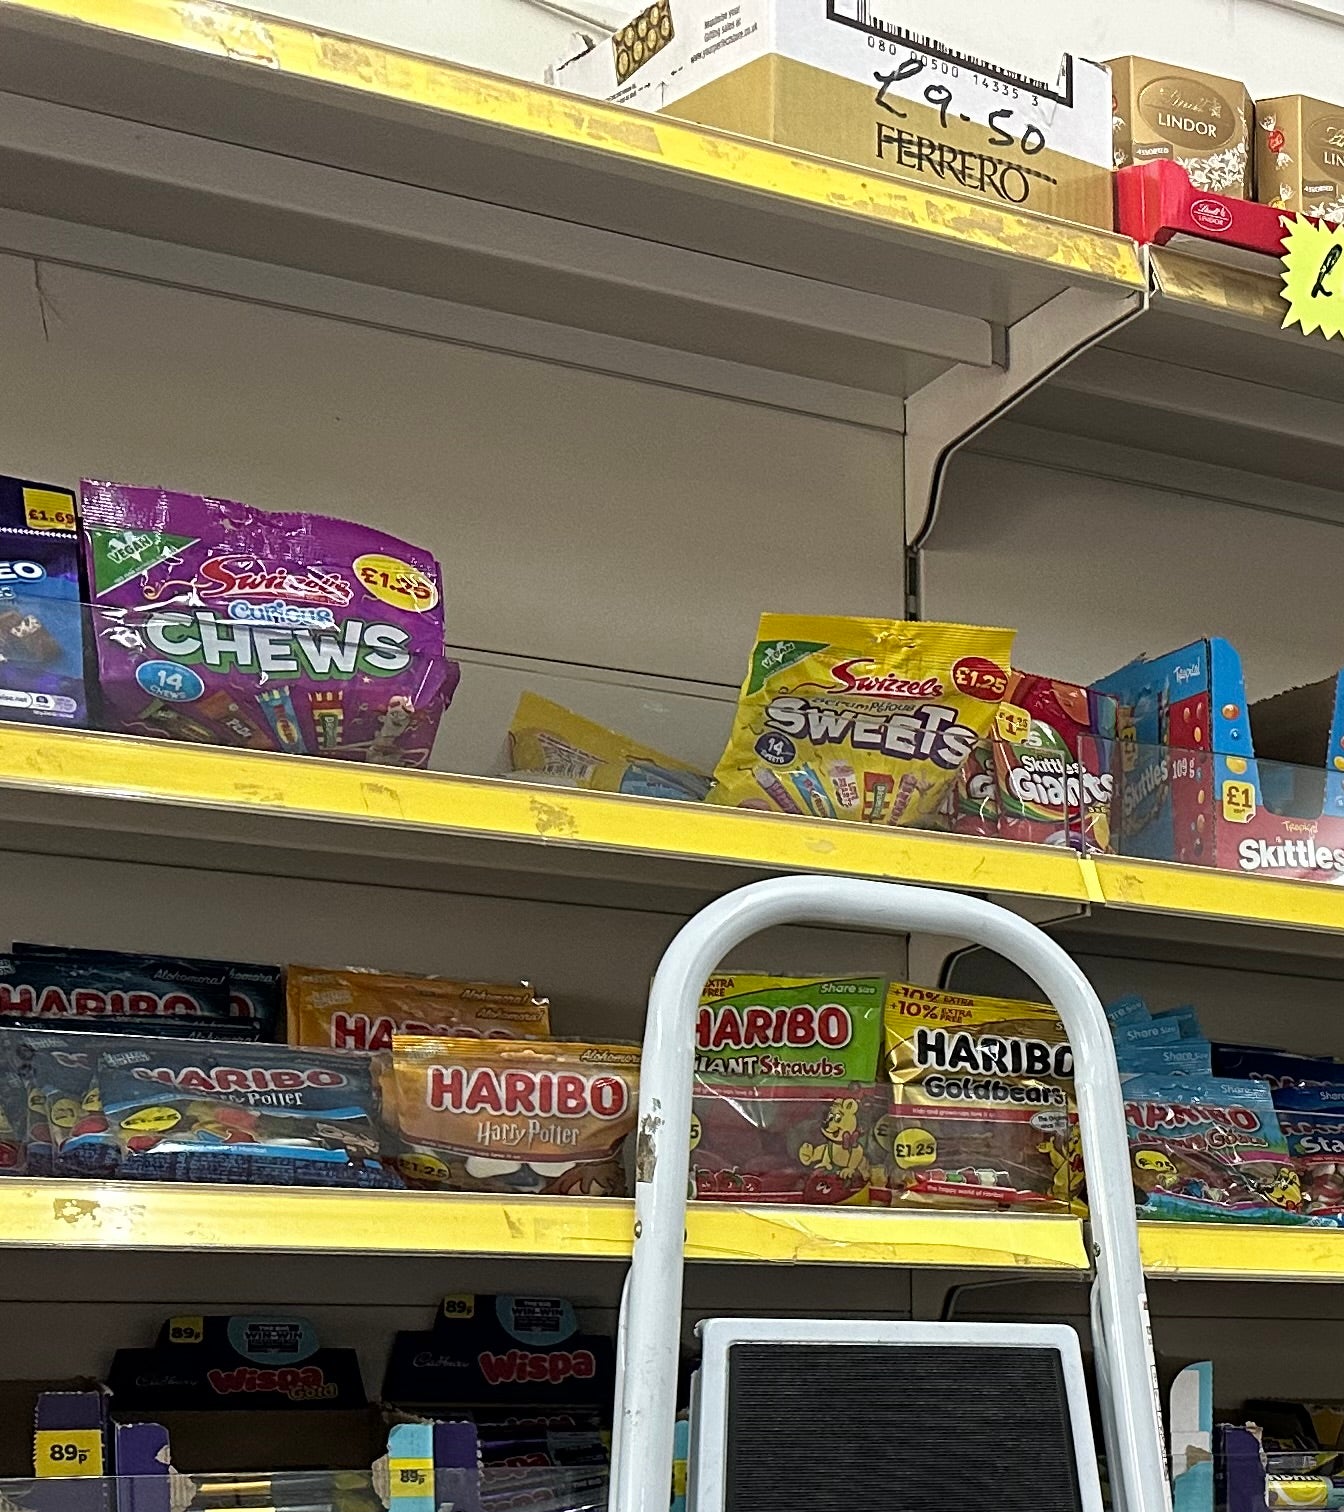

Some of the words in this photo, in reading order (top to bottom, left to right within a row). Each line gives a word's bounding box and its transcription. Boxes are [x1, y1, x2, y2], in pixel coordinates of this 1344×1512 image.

[867, 35, 897, 56] 080
[973, 74, 1019, 100] 14335
[1031, 95, 1039, 107] 3
[1158, 112, 1217, 138] LINDOR
[876, 122, 1030, 203] FERRERO
[1135, 146, 1171, 157] ASSORTED
[1304, 184, 1335, 194] ASSORTED
[1198, 214, 1226, 227] LINDOR
[29, 509, 75, 524] £1.69
[108, 535, 152, 563] VEGAN
[360, 566, 435, 600] £1.25
[145, 610, 411, 676] CHEWS
[761, 642, 796, 669] VEGAN
[158, 668, 183, 692] 14
[827, 658, 945, 699] Swizzels
[955, 666, 1007, 694] £1.25
[765, 696, 979, 769] SWEETS
[999, 711, 1029, 736] £1.25
[768, 737, 784, 754] 14
[1021, 754, 1086, 775] Skittles
[1012, 767, 1114, 806] Giants
[1227, 785, 1252, 808] £1
[820, 982, 857, 994] Share
[890, 1001, 938, 1020] +10%
[940, 1007, 973, 1019] EXTRA
[1127, 1026, 1159, 1041] Share
[915, 1029, 1074, 1078] HARIBO
[759, 1055, 845, 1077] Strawbs
[131, 1066, 348, 1093] HARIBO
[924, 1076, 1067, 1106] Goldbears
[428, 1066, 628, 1120] HARIBO
[476, 1119, 528, 1146] Harry
[528, 1123, 580, 1148] Potter
[896, 1142, 936, 1158] £1.25
[400, 1157, 449, 1179] £1.25
[446, 1300, 471, 1316] 89p
[512, 1306, 564, 1317] WIN-WIN
[172, 1327, 202, 1341] 89p
[478, 1350, 595, 1384] Wispa
[208, 1366, 325, 1395] Wispa
[289, 1383, 338, 1400] Gold
[49, 1444, 89, 1464] 89p
